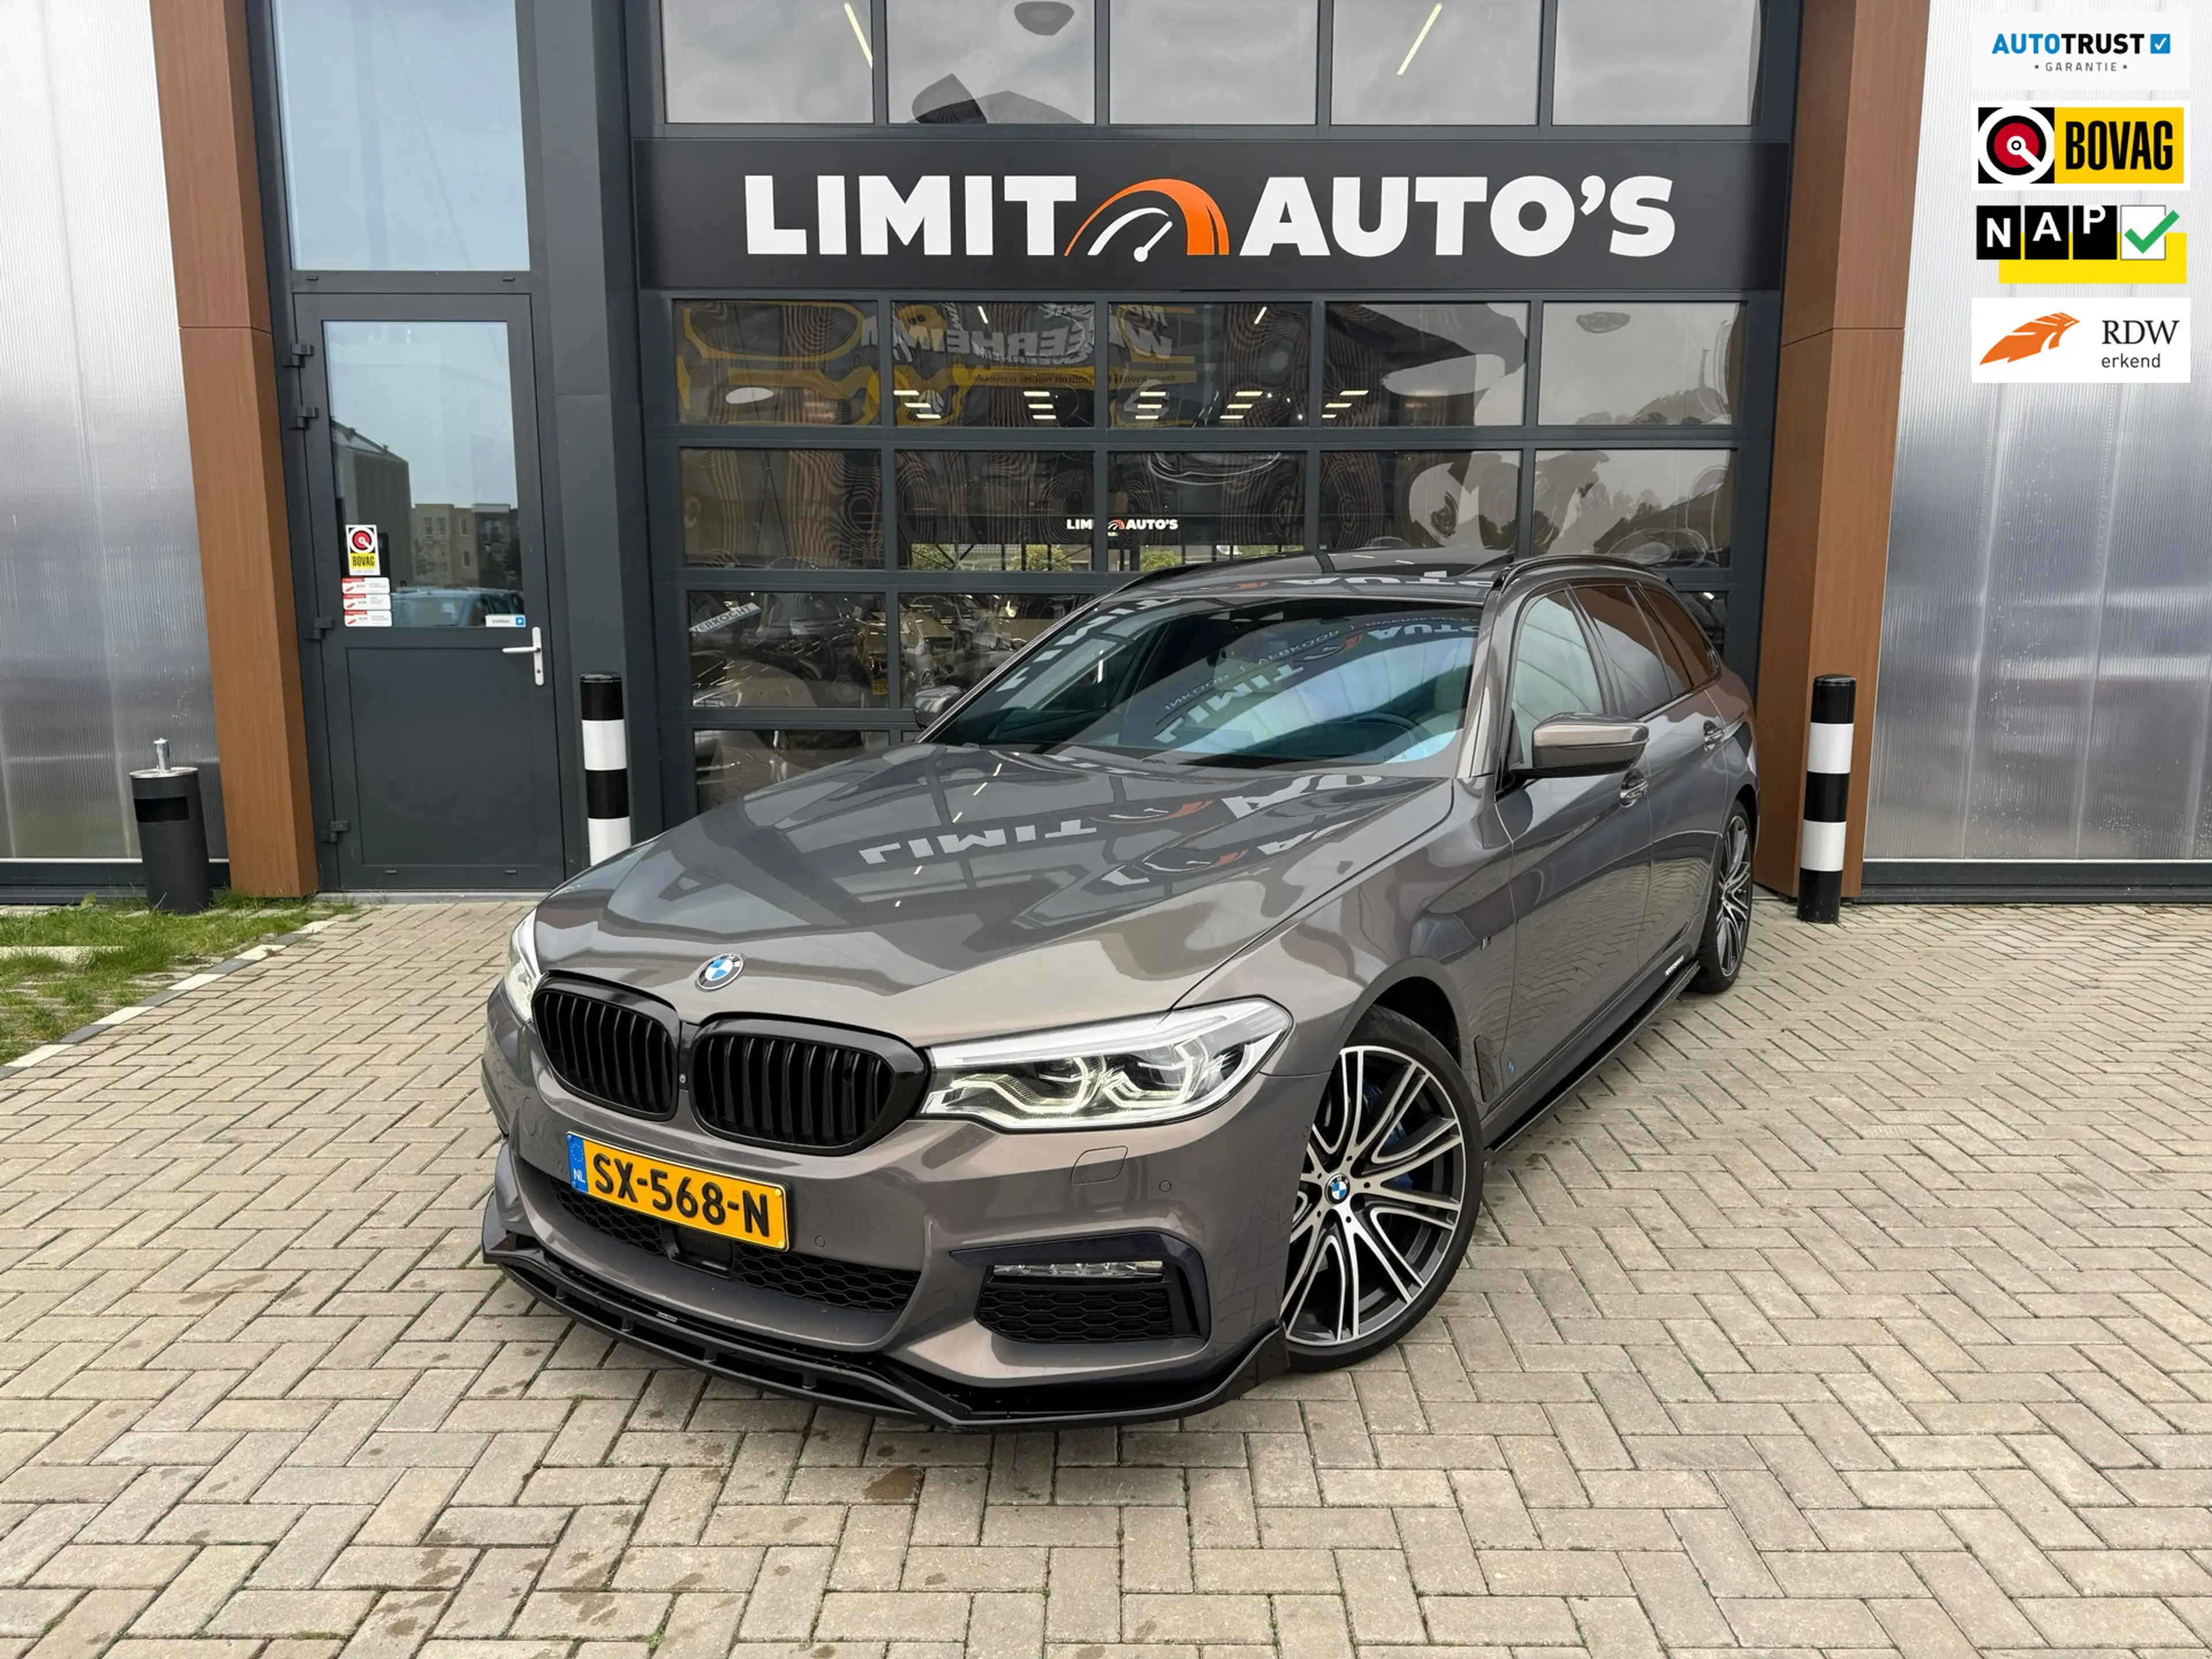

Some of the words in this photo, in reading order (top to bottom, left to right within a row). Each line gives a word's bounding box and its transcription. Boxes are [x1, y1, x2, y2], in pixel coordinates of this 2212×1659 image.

[744, 175, 1076, 256] LIMIT
[1240, 175, 1675, 257] AUTO'S
[1066, 519, 1092, 530] LIM
[1126, 519, 1179, 530] AUTO'S
[352, 556, 375, 567] BOVAG
[573, 1168, 586, 1184] NL
[593, 1153, 770, 1237] SX-568-N
